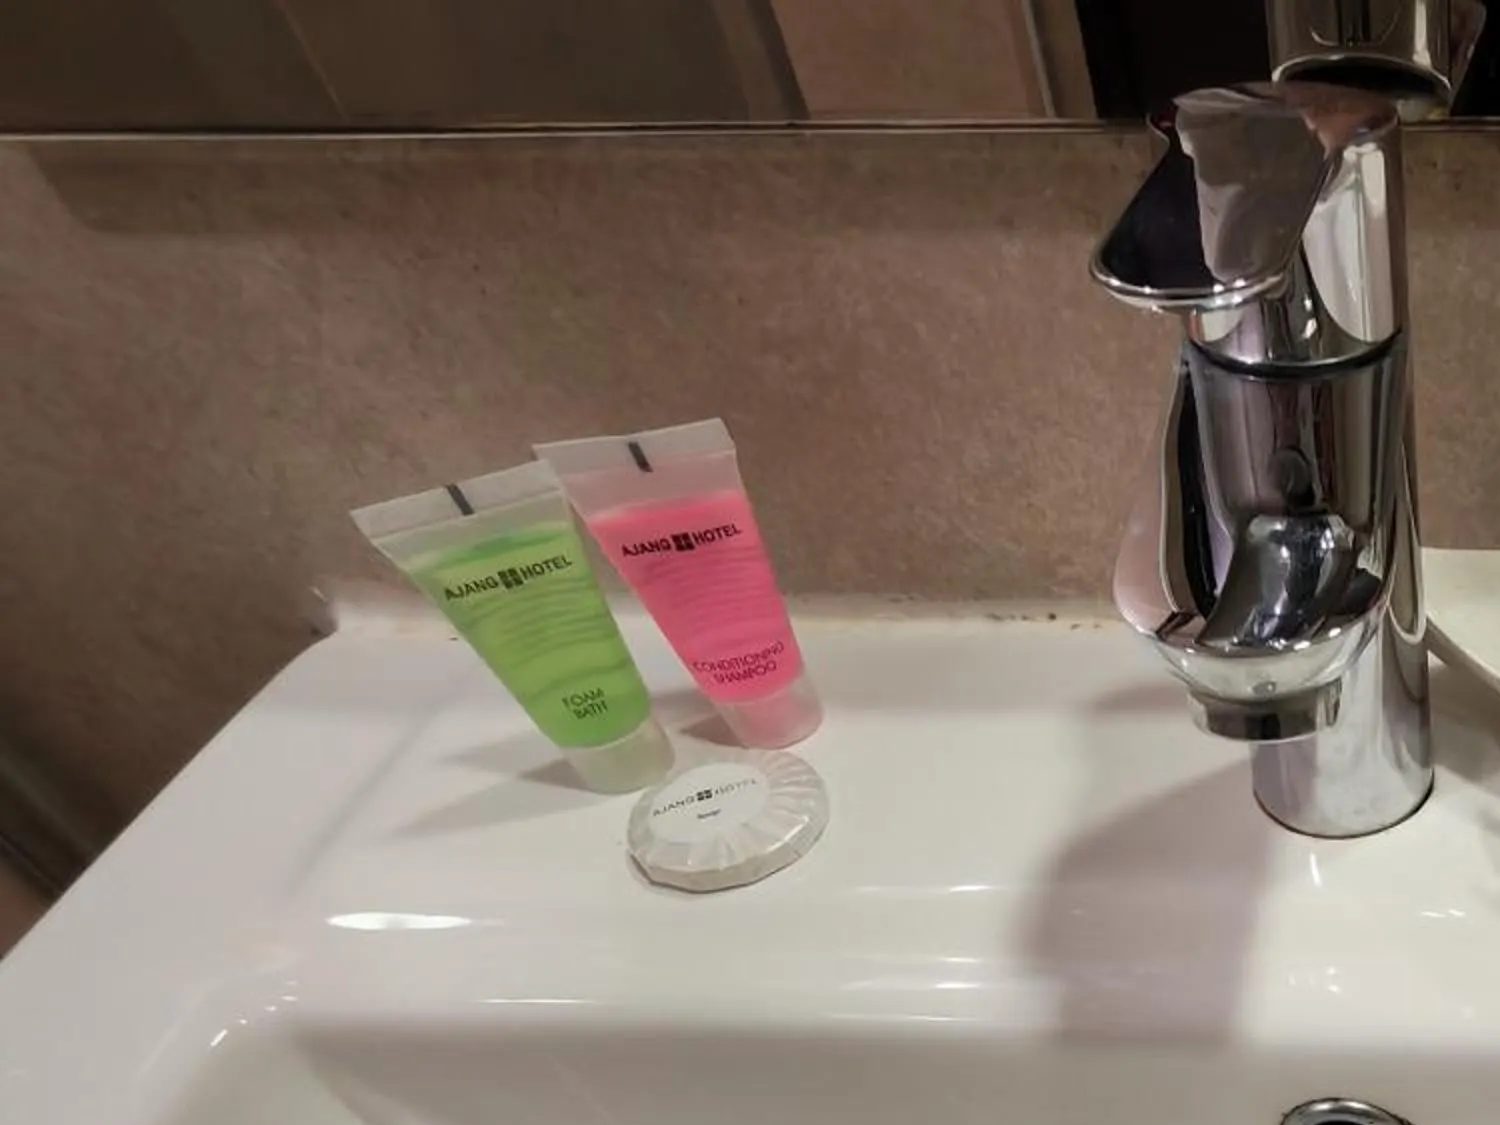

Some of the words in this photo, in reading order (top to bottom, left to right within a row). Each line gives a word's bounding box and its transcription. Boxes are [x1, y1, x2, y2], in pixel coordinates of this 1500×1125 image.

[621, 538, 672, 557] AJANG
[691, 523, 742, 547] HOTEL
[444, 575, 499, 601] AJANG
[519, 554, 573, 580] HOTEL
[573, 700, 608, 720] BATH
